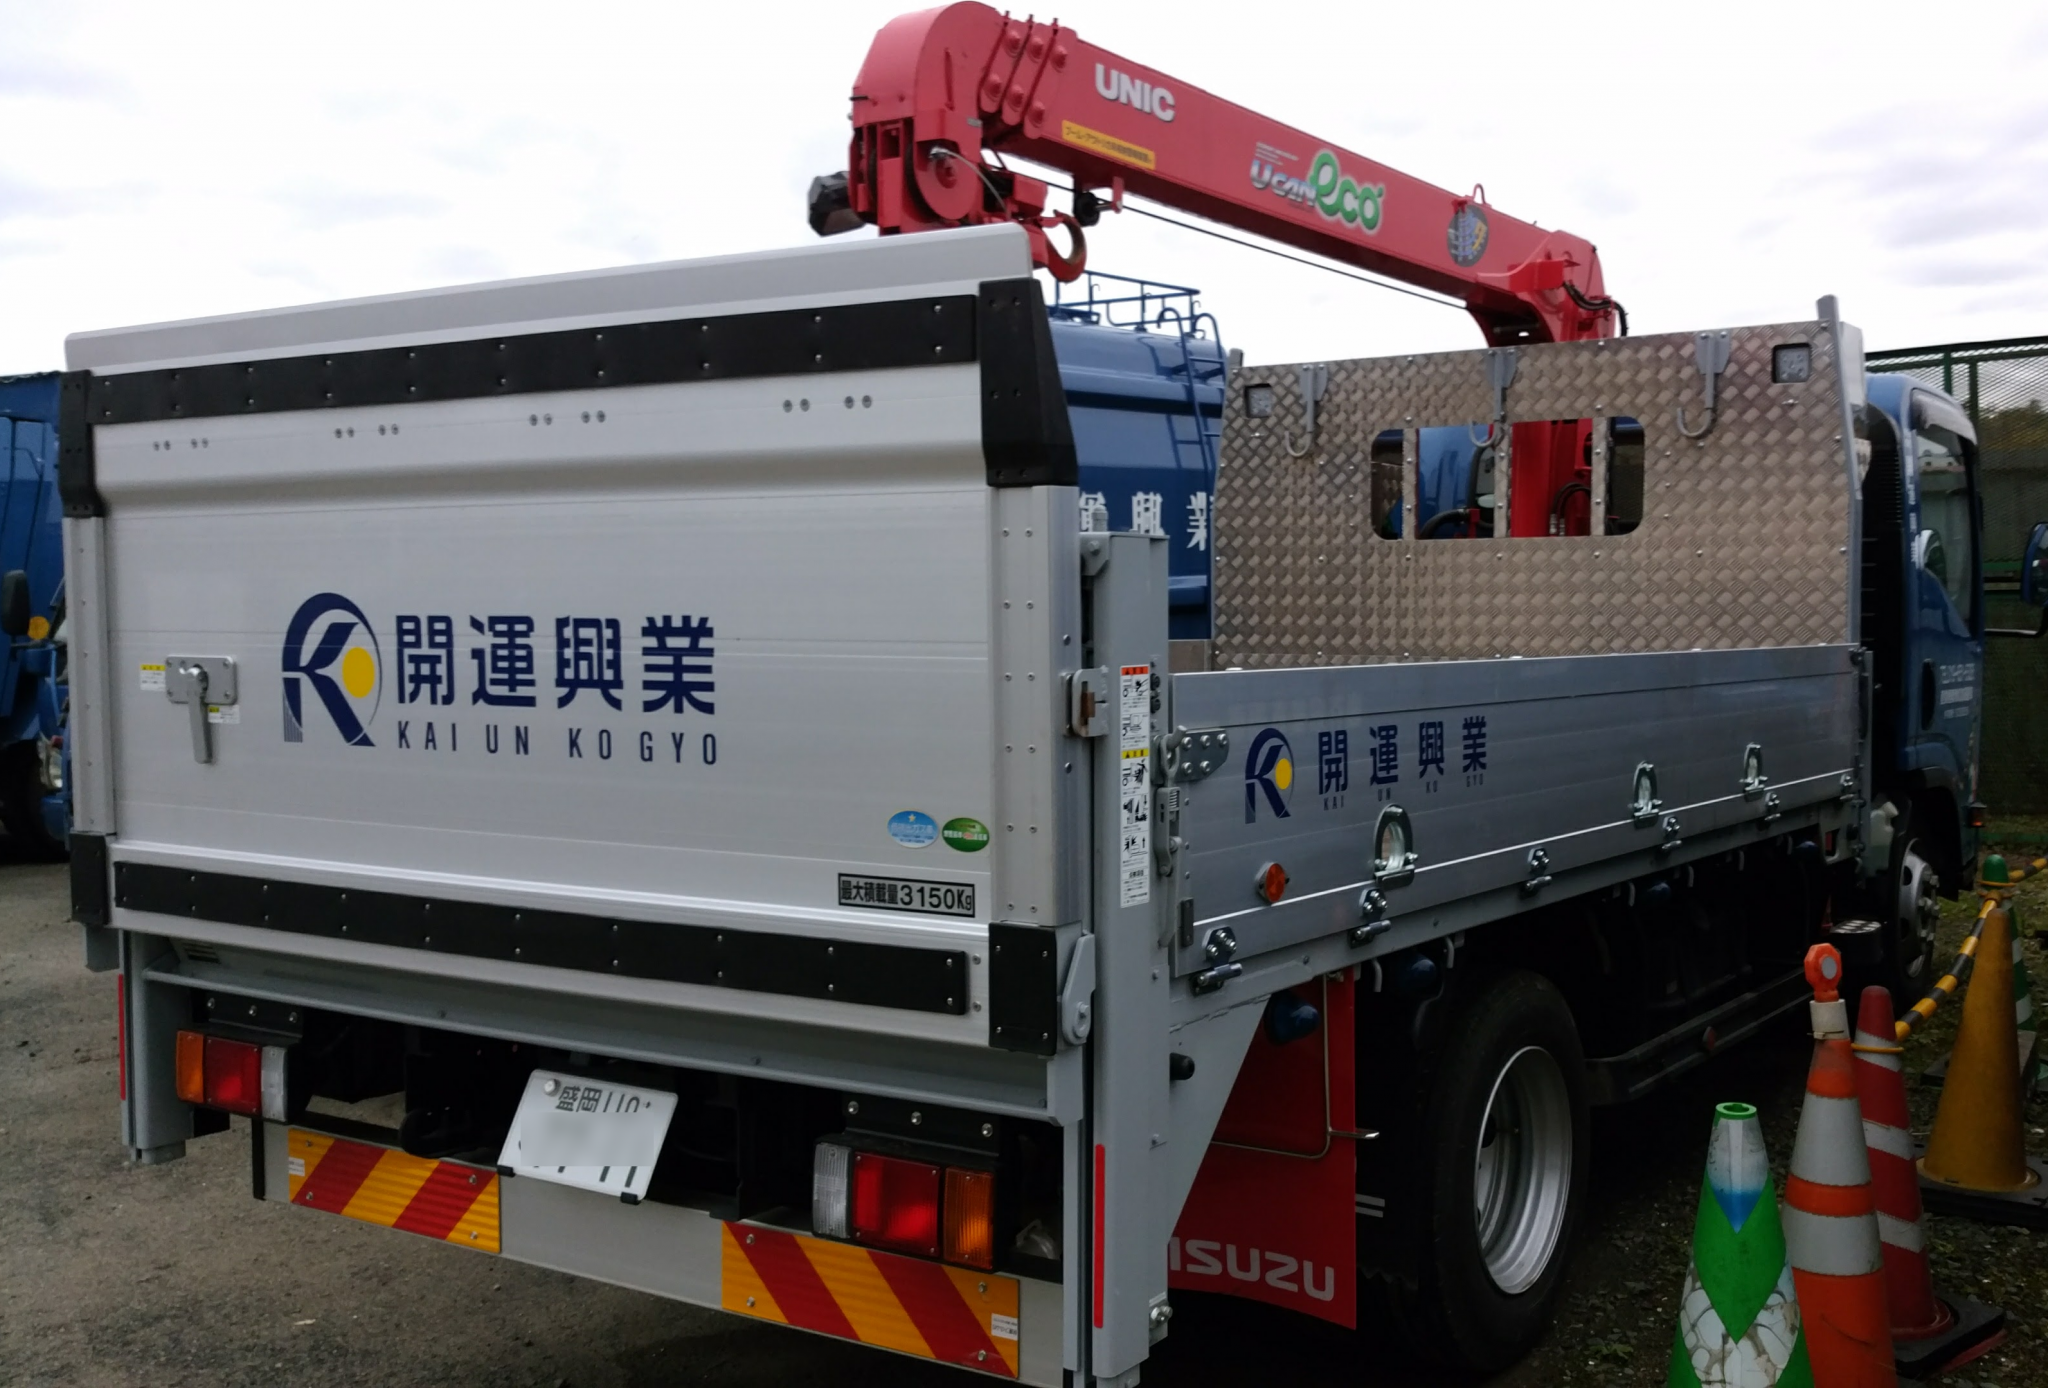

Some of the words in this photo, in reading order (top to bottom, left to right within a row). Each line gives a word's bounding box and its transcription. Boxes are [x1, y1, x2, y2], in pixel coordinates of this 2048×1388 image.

[1095, 62, 1175, 122] UNIC
[395, 615, 716, 715] 開運興業
[1318, 715, 1487, 795] 開運興業
[1169, 1236, 1335, 1301] ISUZU
